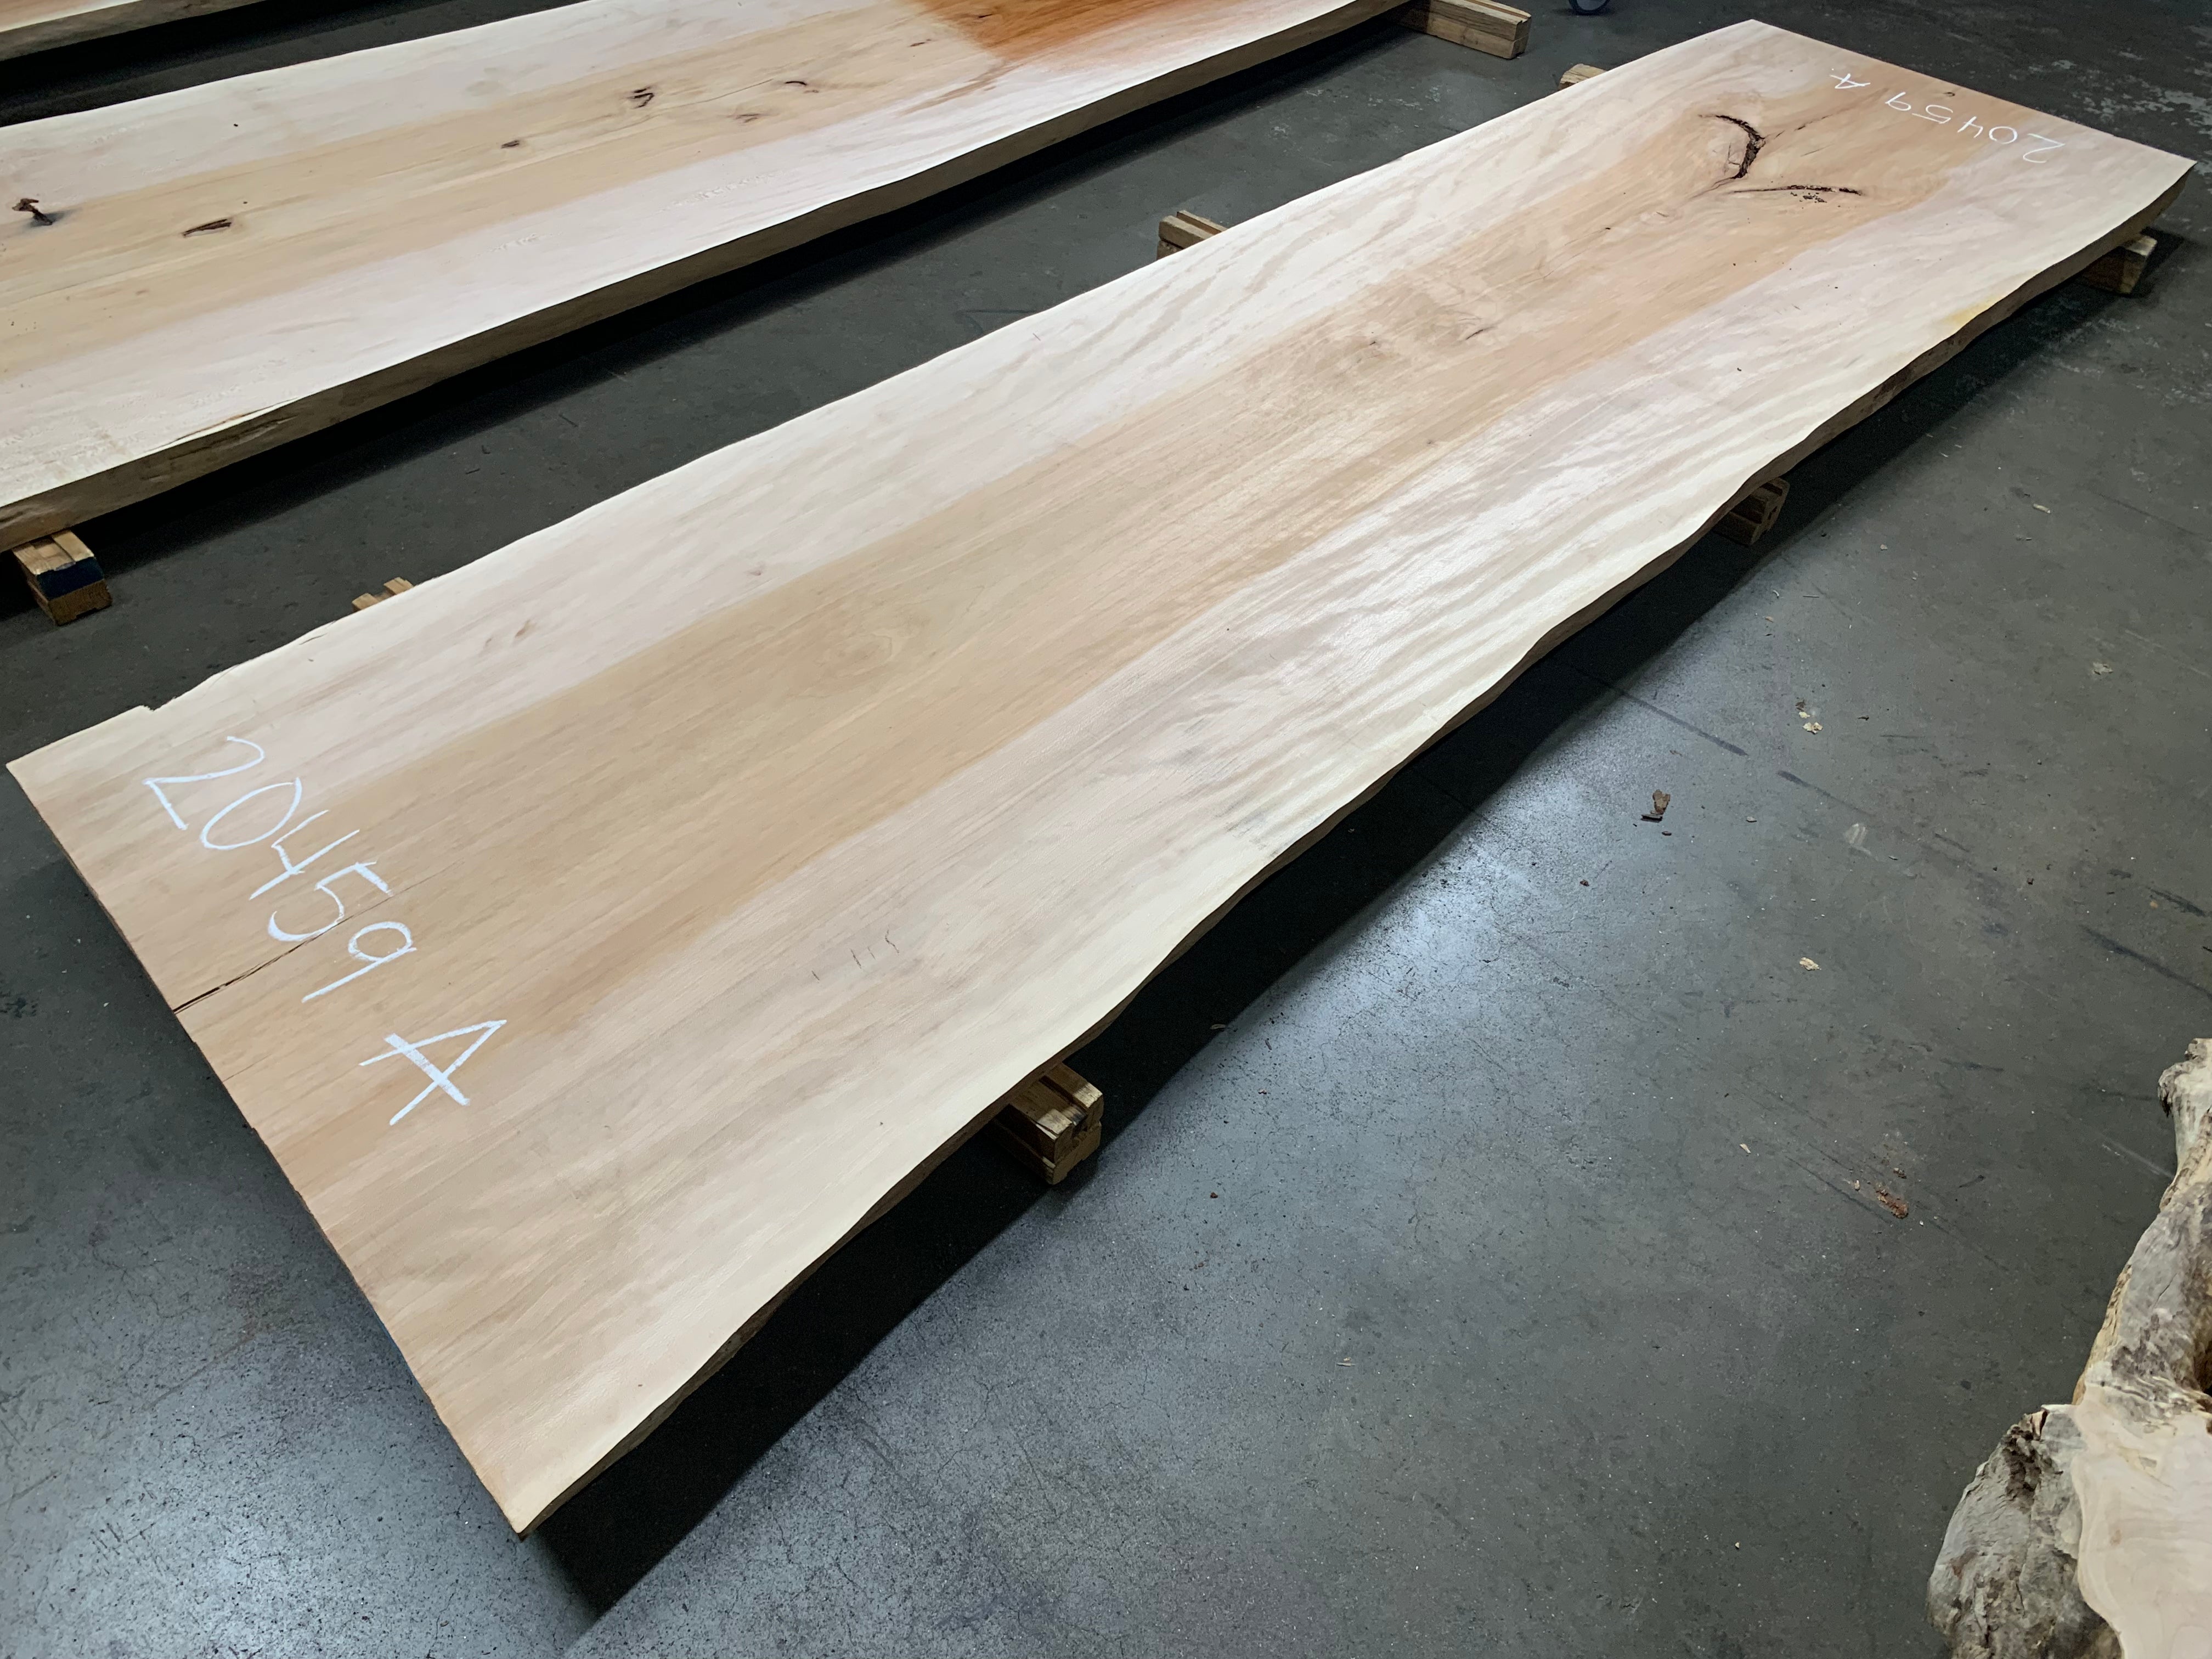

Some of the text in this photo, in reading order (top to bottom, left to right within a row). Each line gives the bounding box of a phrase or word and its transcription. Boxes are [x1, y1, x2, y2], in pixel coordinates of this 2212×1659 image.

[1829, 73, 2066, 163] 20459 A
[142, 736, 507, 1126] 20459 A
